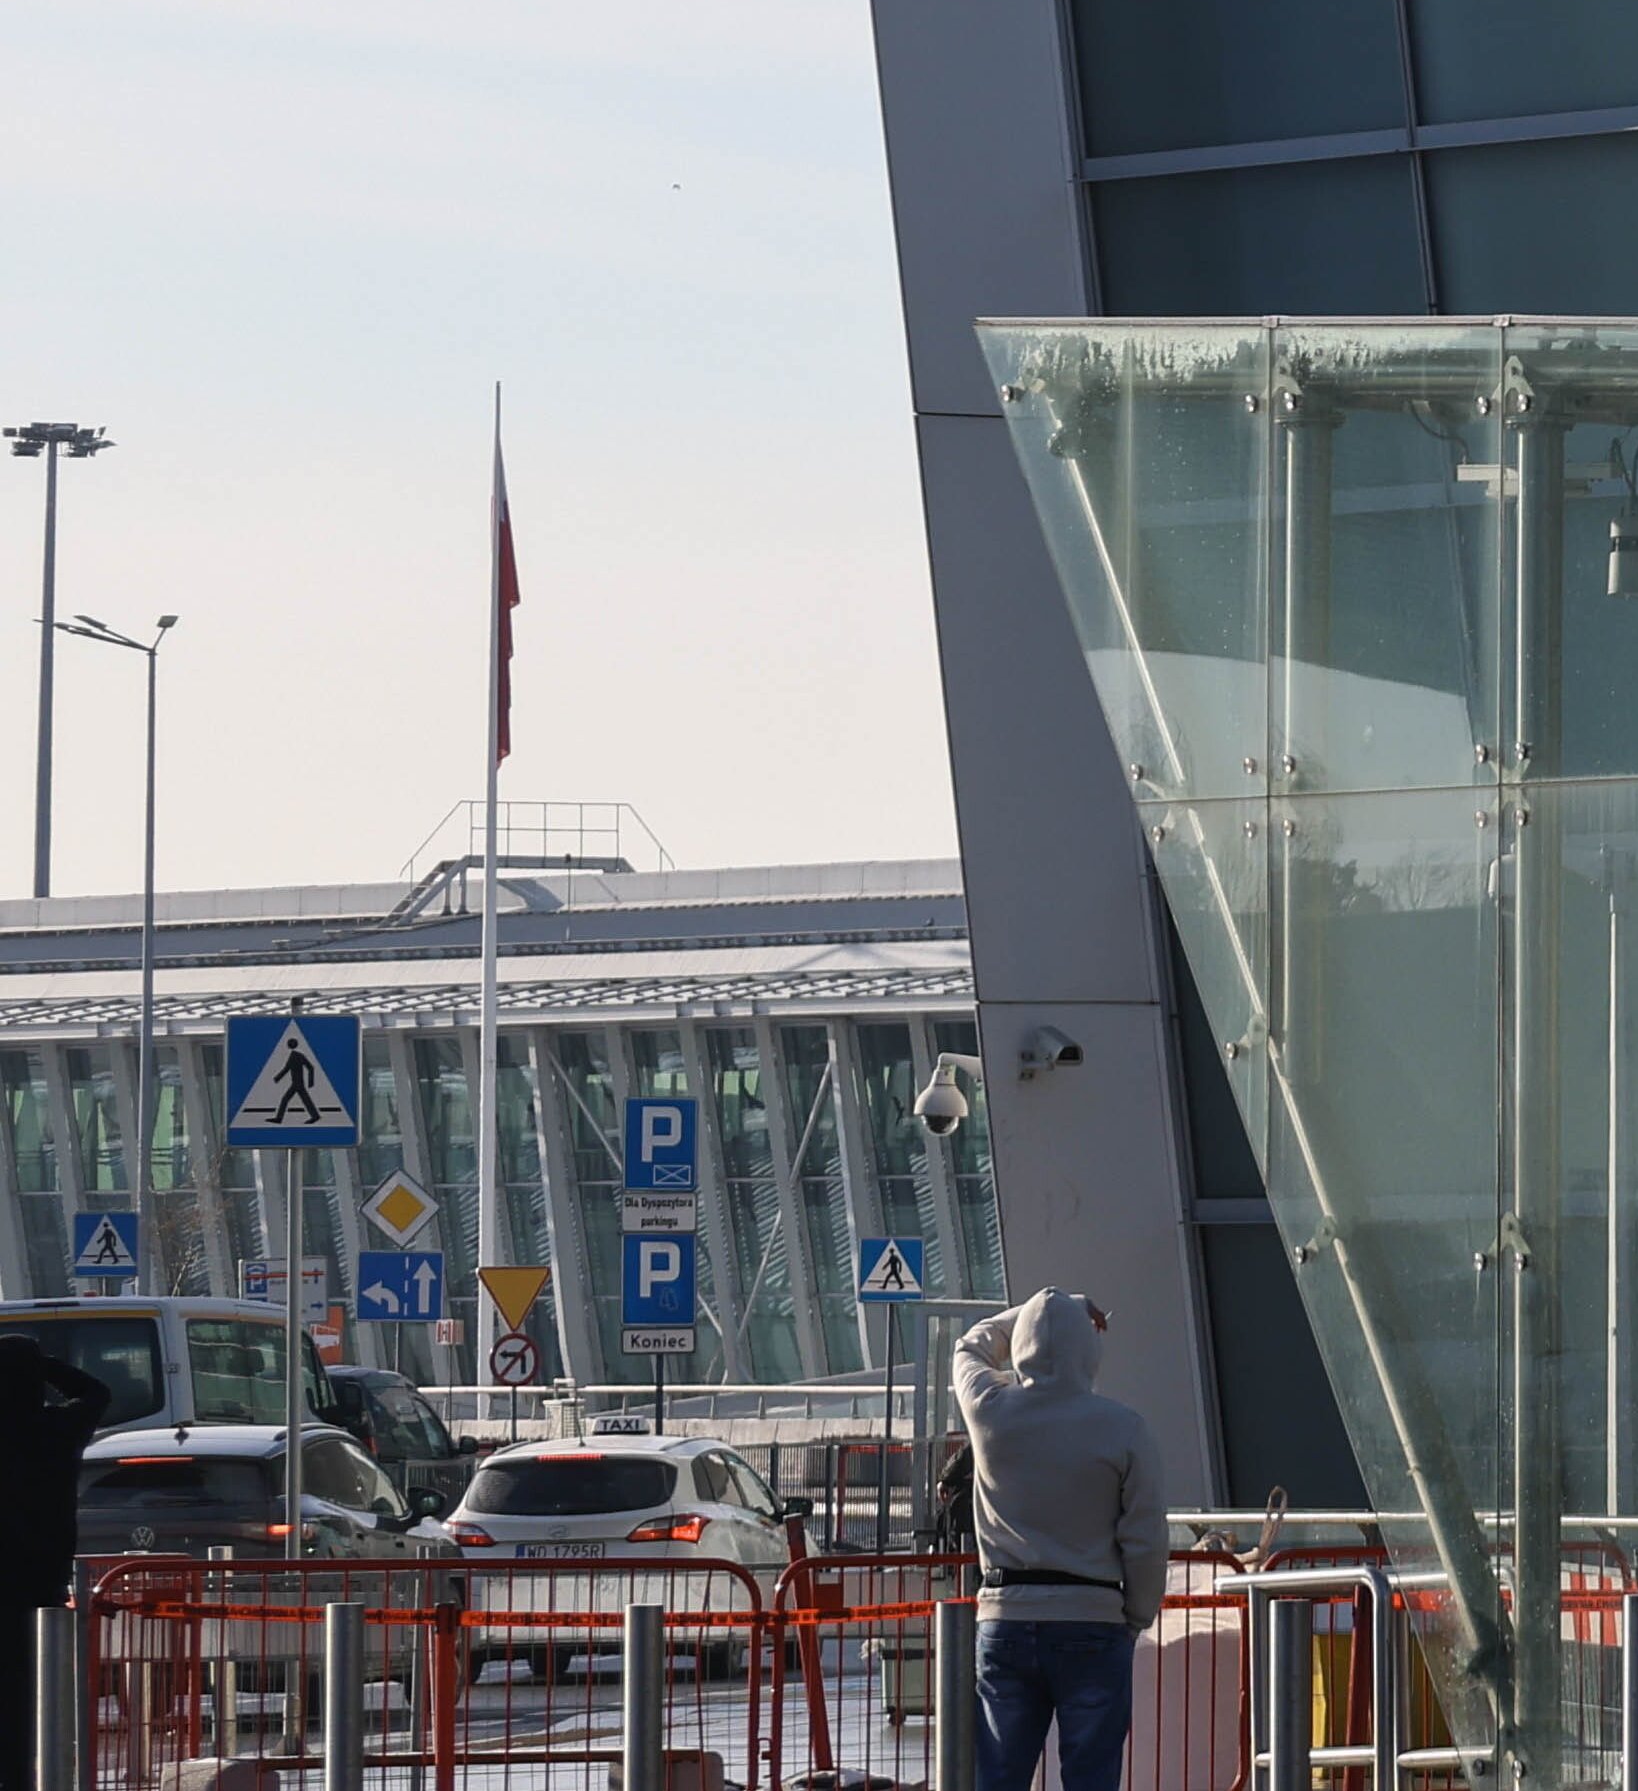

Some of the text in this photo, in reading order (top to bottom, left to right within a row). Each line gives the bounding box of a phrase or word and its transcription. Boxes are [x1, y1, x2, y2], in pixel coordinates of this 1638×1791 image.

[641, 1106, 682, 1162] P
[625, 1197, 639, 1208] Dla
[641, 1216, 678, 1229] parkingu
[640, 1241, 681, 1298] P
[631, 1333, 687, 1348] Koniec
[601, 1419, 639, 1430] TAXI
